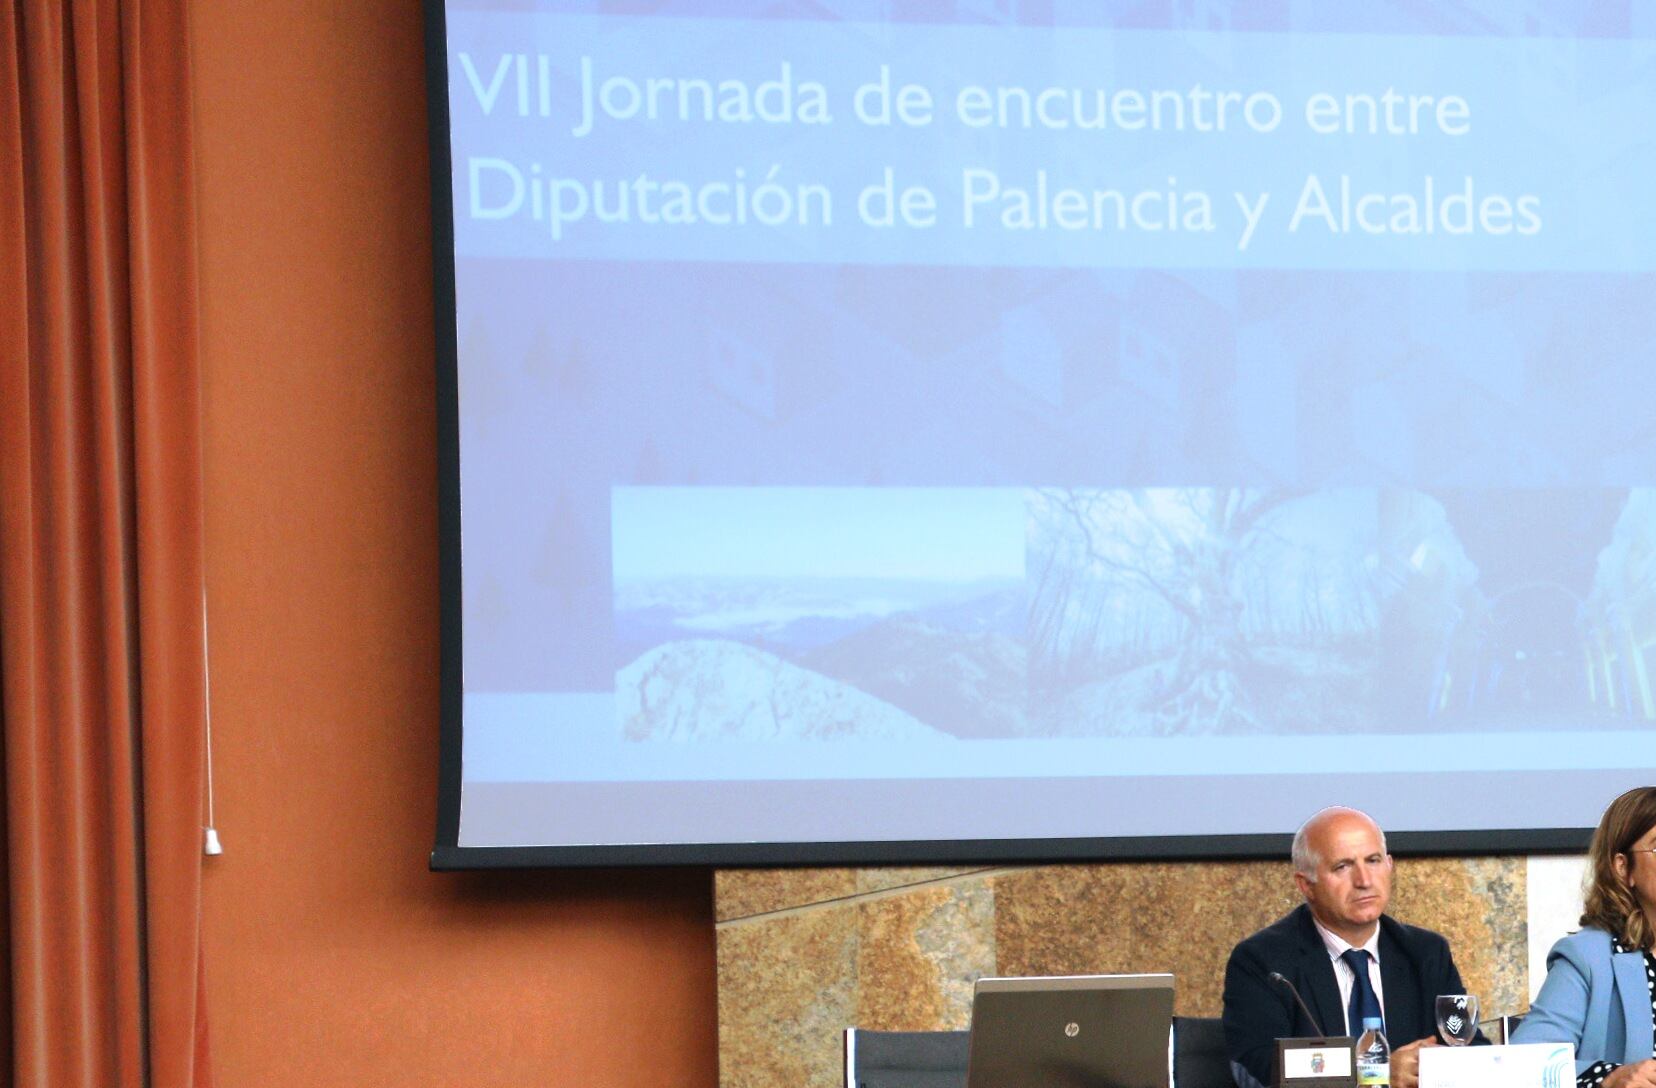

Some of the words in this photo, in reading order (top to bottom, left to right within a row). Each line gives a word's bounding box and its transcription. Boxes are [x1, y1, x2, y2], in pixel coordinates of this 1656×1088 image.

[458, 53, 550, 117] VII
[571, 55, 832, 137] Jornada
[853, 64, 934, 126] de
[956, 83, 1282, 132] encuentro
[1305, 86, 1470, 136] entre
[468, 157, 832, 241] Diputación
[857, 167, 936, 228] de
[962, 169, 1216, 232] Palencia
[1234, 191, 1269, 251] y
[1288, 173, 1543, 235] Alcaldes
[1064, 1022, 1080, 1038] hp
